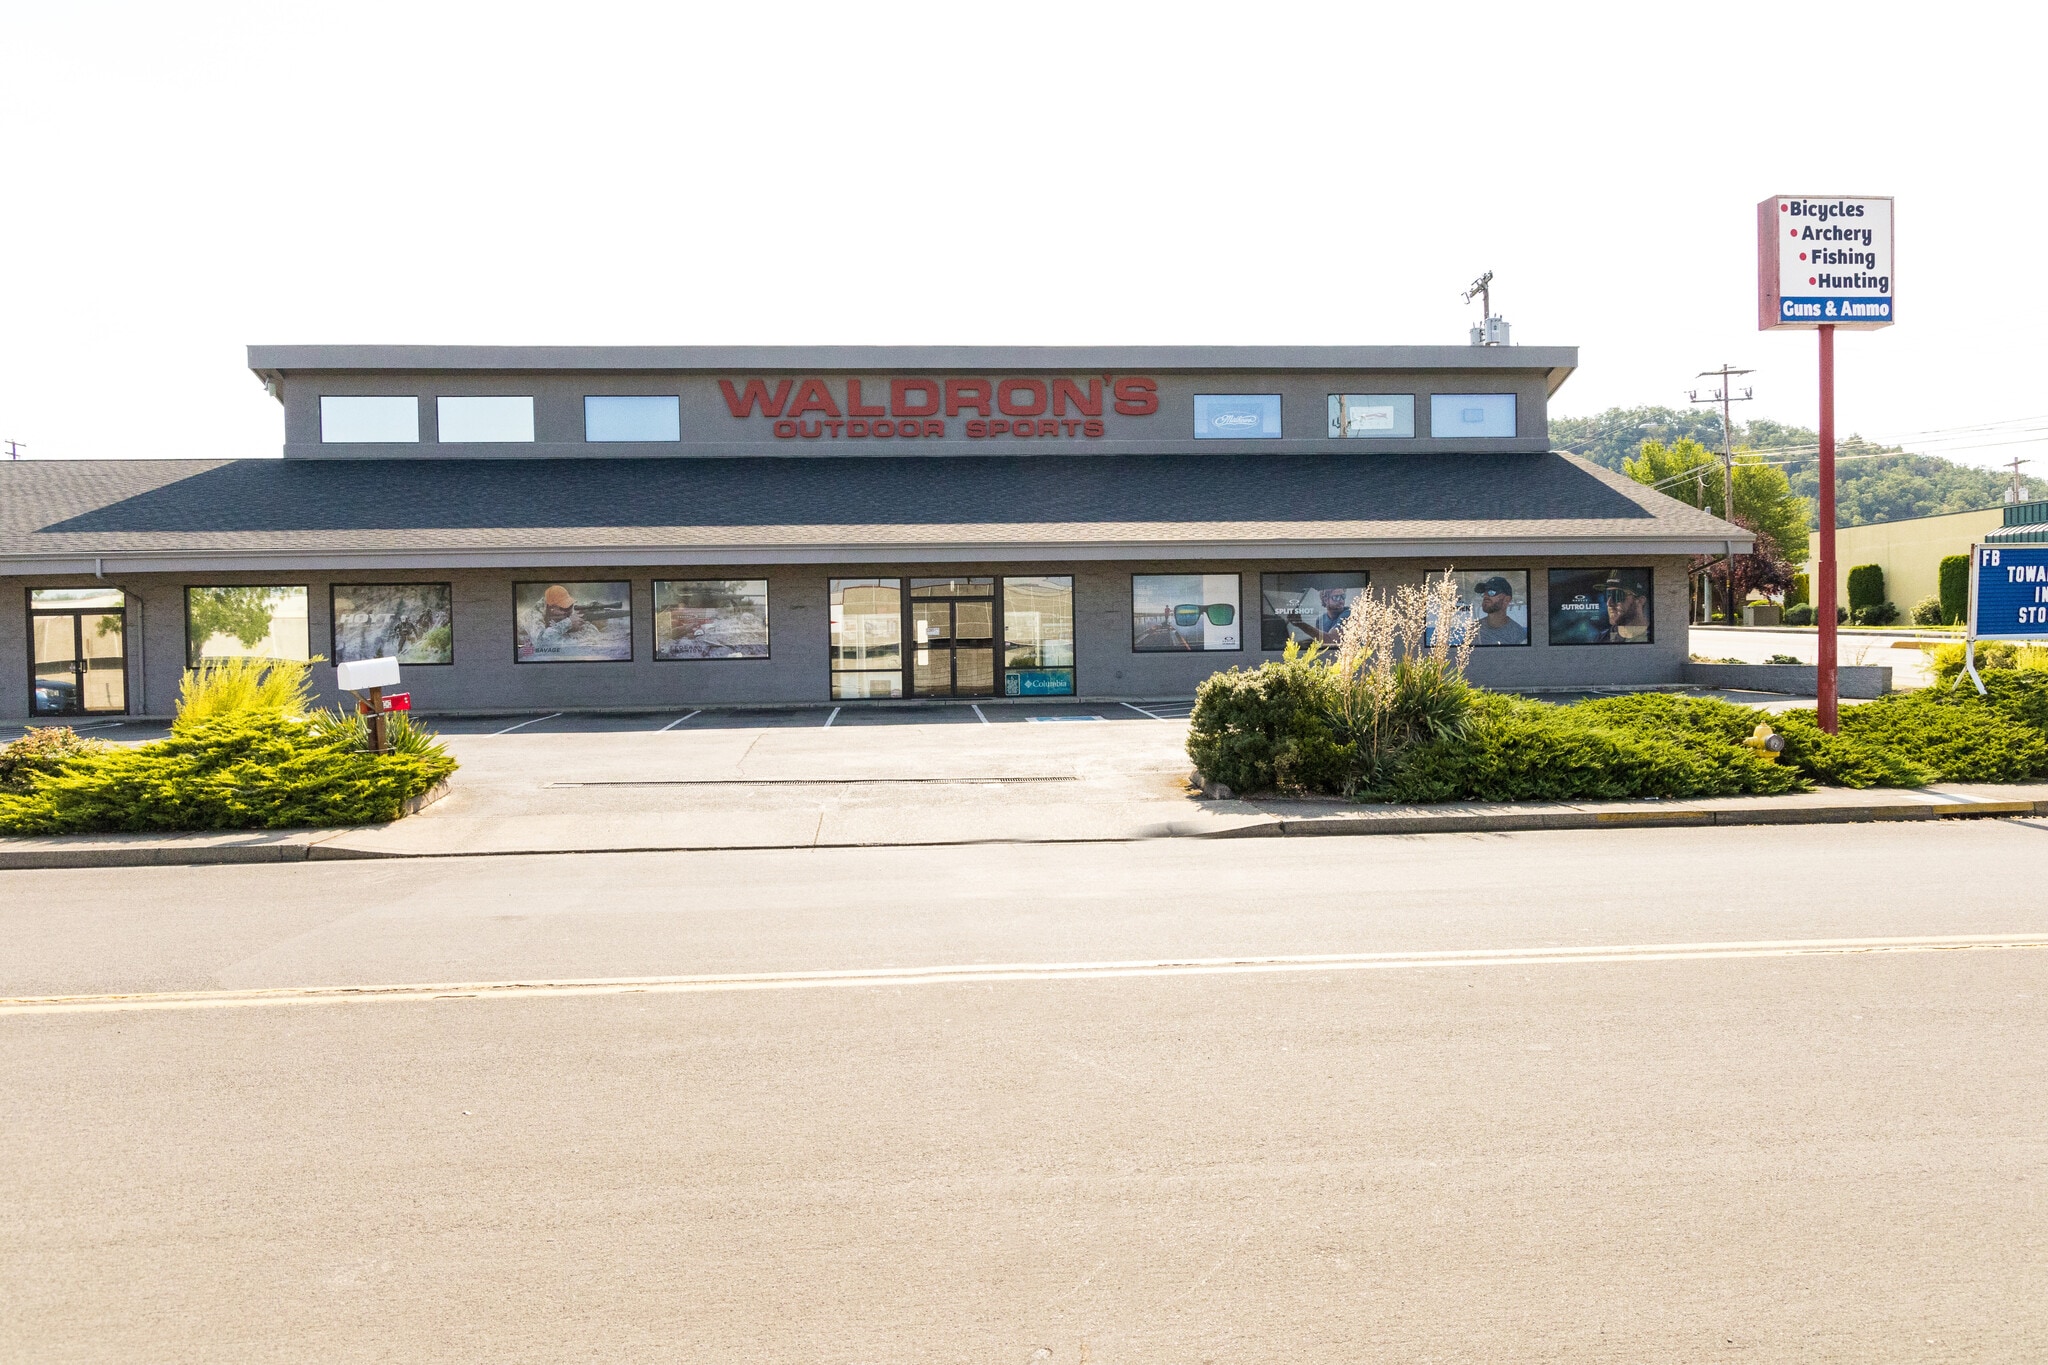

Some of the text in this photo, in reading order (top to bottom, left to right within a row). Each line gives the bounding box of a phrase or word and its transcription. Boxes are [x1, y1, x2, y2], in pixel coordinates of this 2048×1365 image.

[1790, 200, 1865, 222] Bicycles
[1801, 225, 1872, 247] Archery
[1811, 248, 1876, 270] Fishing
[1818, 272, 1889, 294] Hunting
[1782, 300, 1890, 317] Guns & Ammo
[718, 373, 1160, 418] WALDRON'S
[773, 418, 1105, 438] OUTDOOR SPORTS
[1982, 549, 2000, 567] FB
[2007, 566, 2048, 582] TOWA
[1294, 607, 1314, 615] SHOT
[1561, 603, 1585, 611] SUTRO
[340, 613, 396, 624] HOYT
[1032, 679, 1067, 688] Columbia
